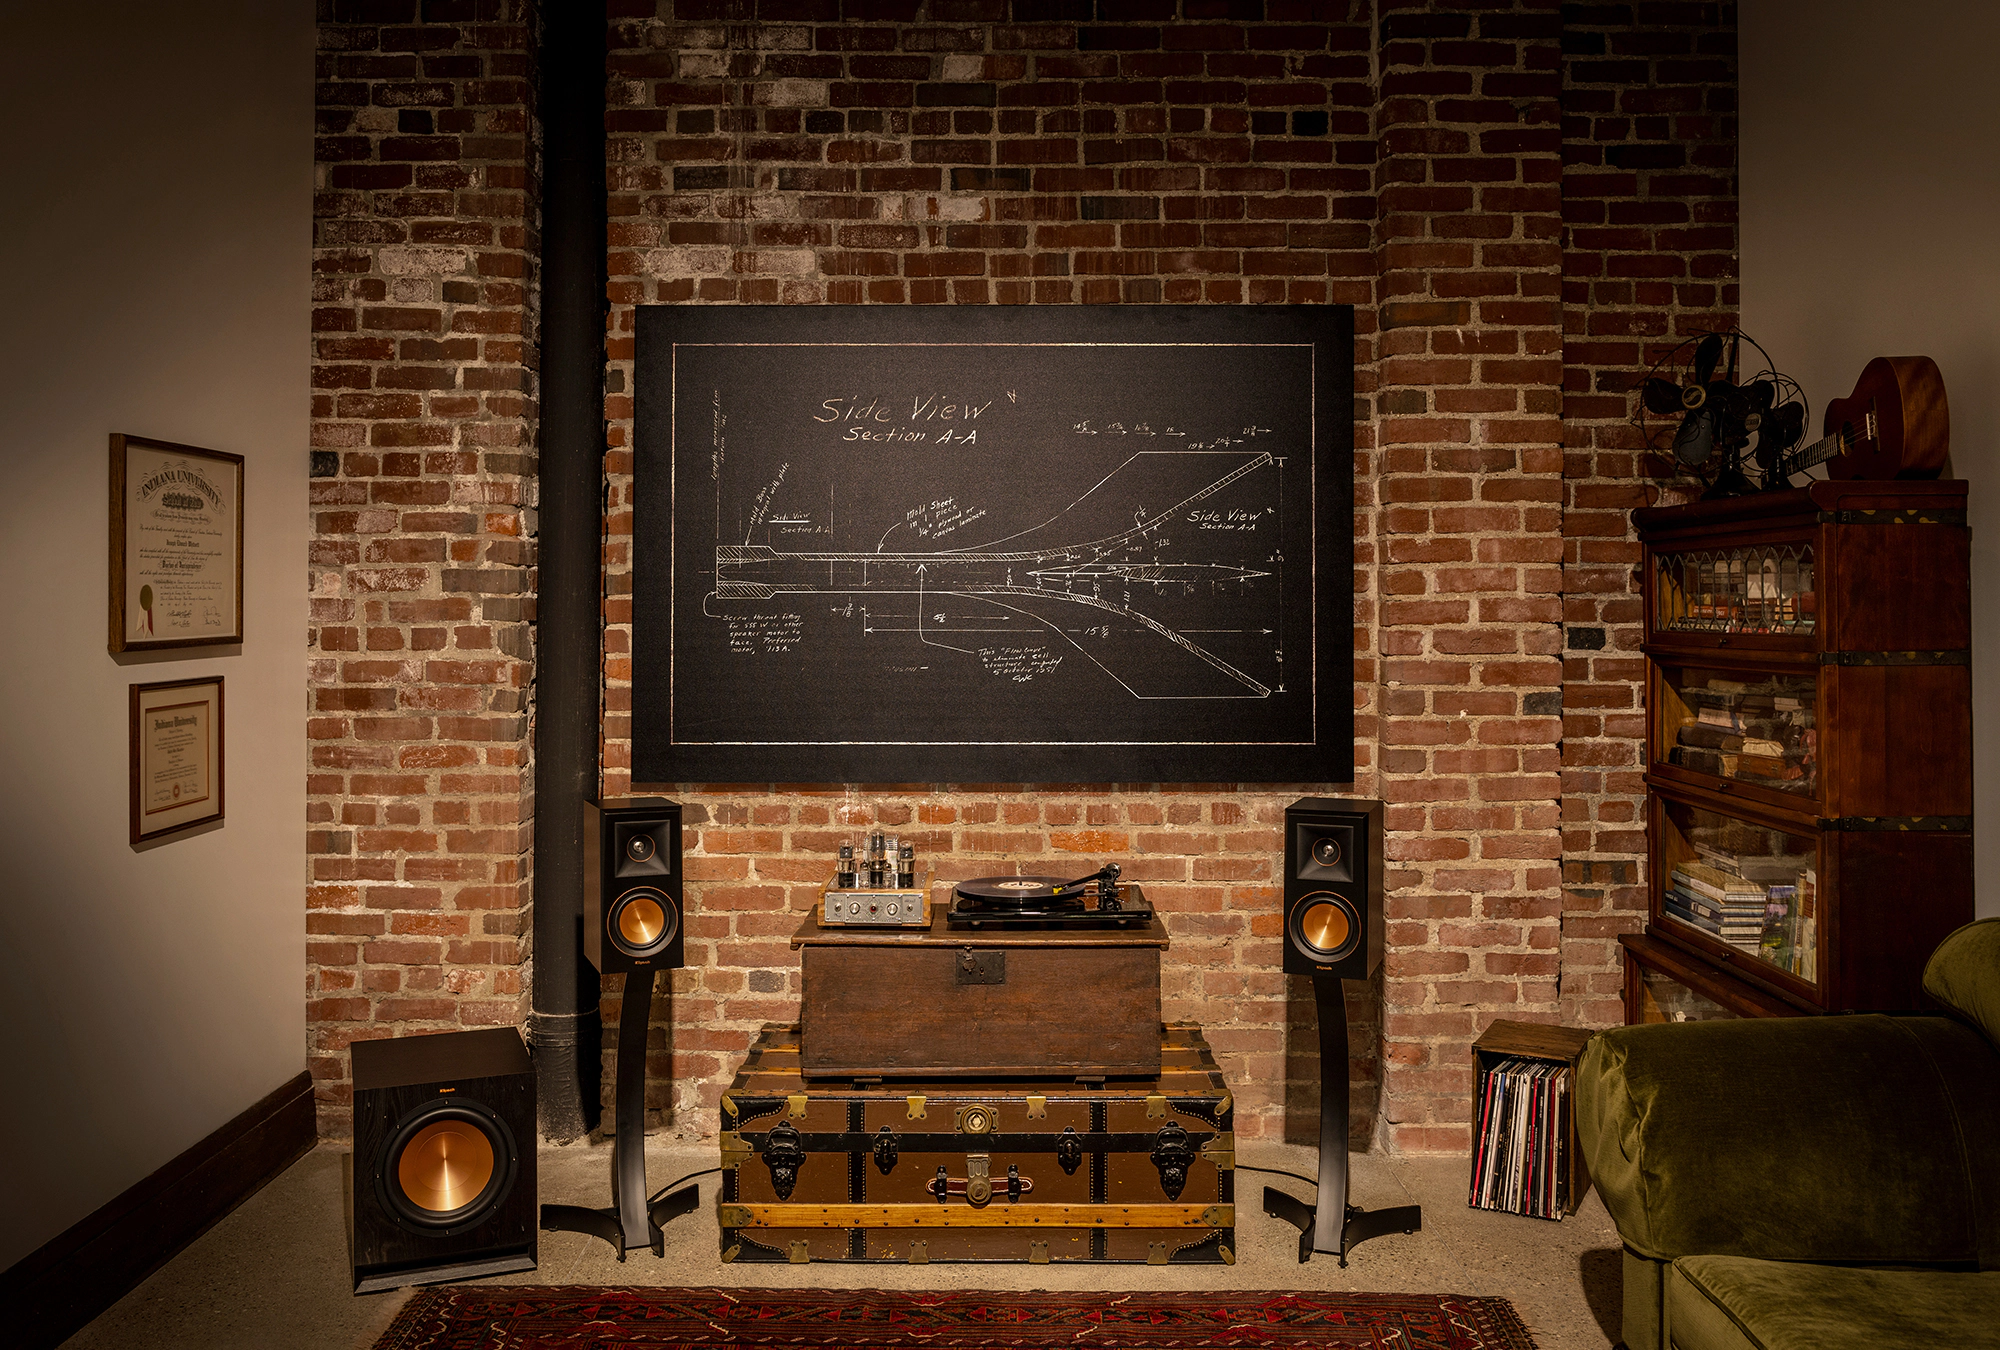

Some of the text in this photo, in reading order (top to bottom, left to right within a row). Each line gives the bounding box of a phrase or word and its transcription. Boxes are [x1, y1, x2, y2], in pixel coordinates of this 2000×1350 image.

[813, 391, 993, 423] Side View
[842, 426, 978, 445] Section A-A
[141, 470, 176, 499] INDIANA
[177, 469, 221, 506] UNIVERSITY
[1186, 507, 1262, 522] Side View
[1199, 522, 1256, 531] Section A-A
